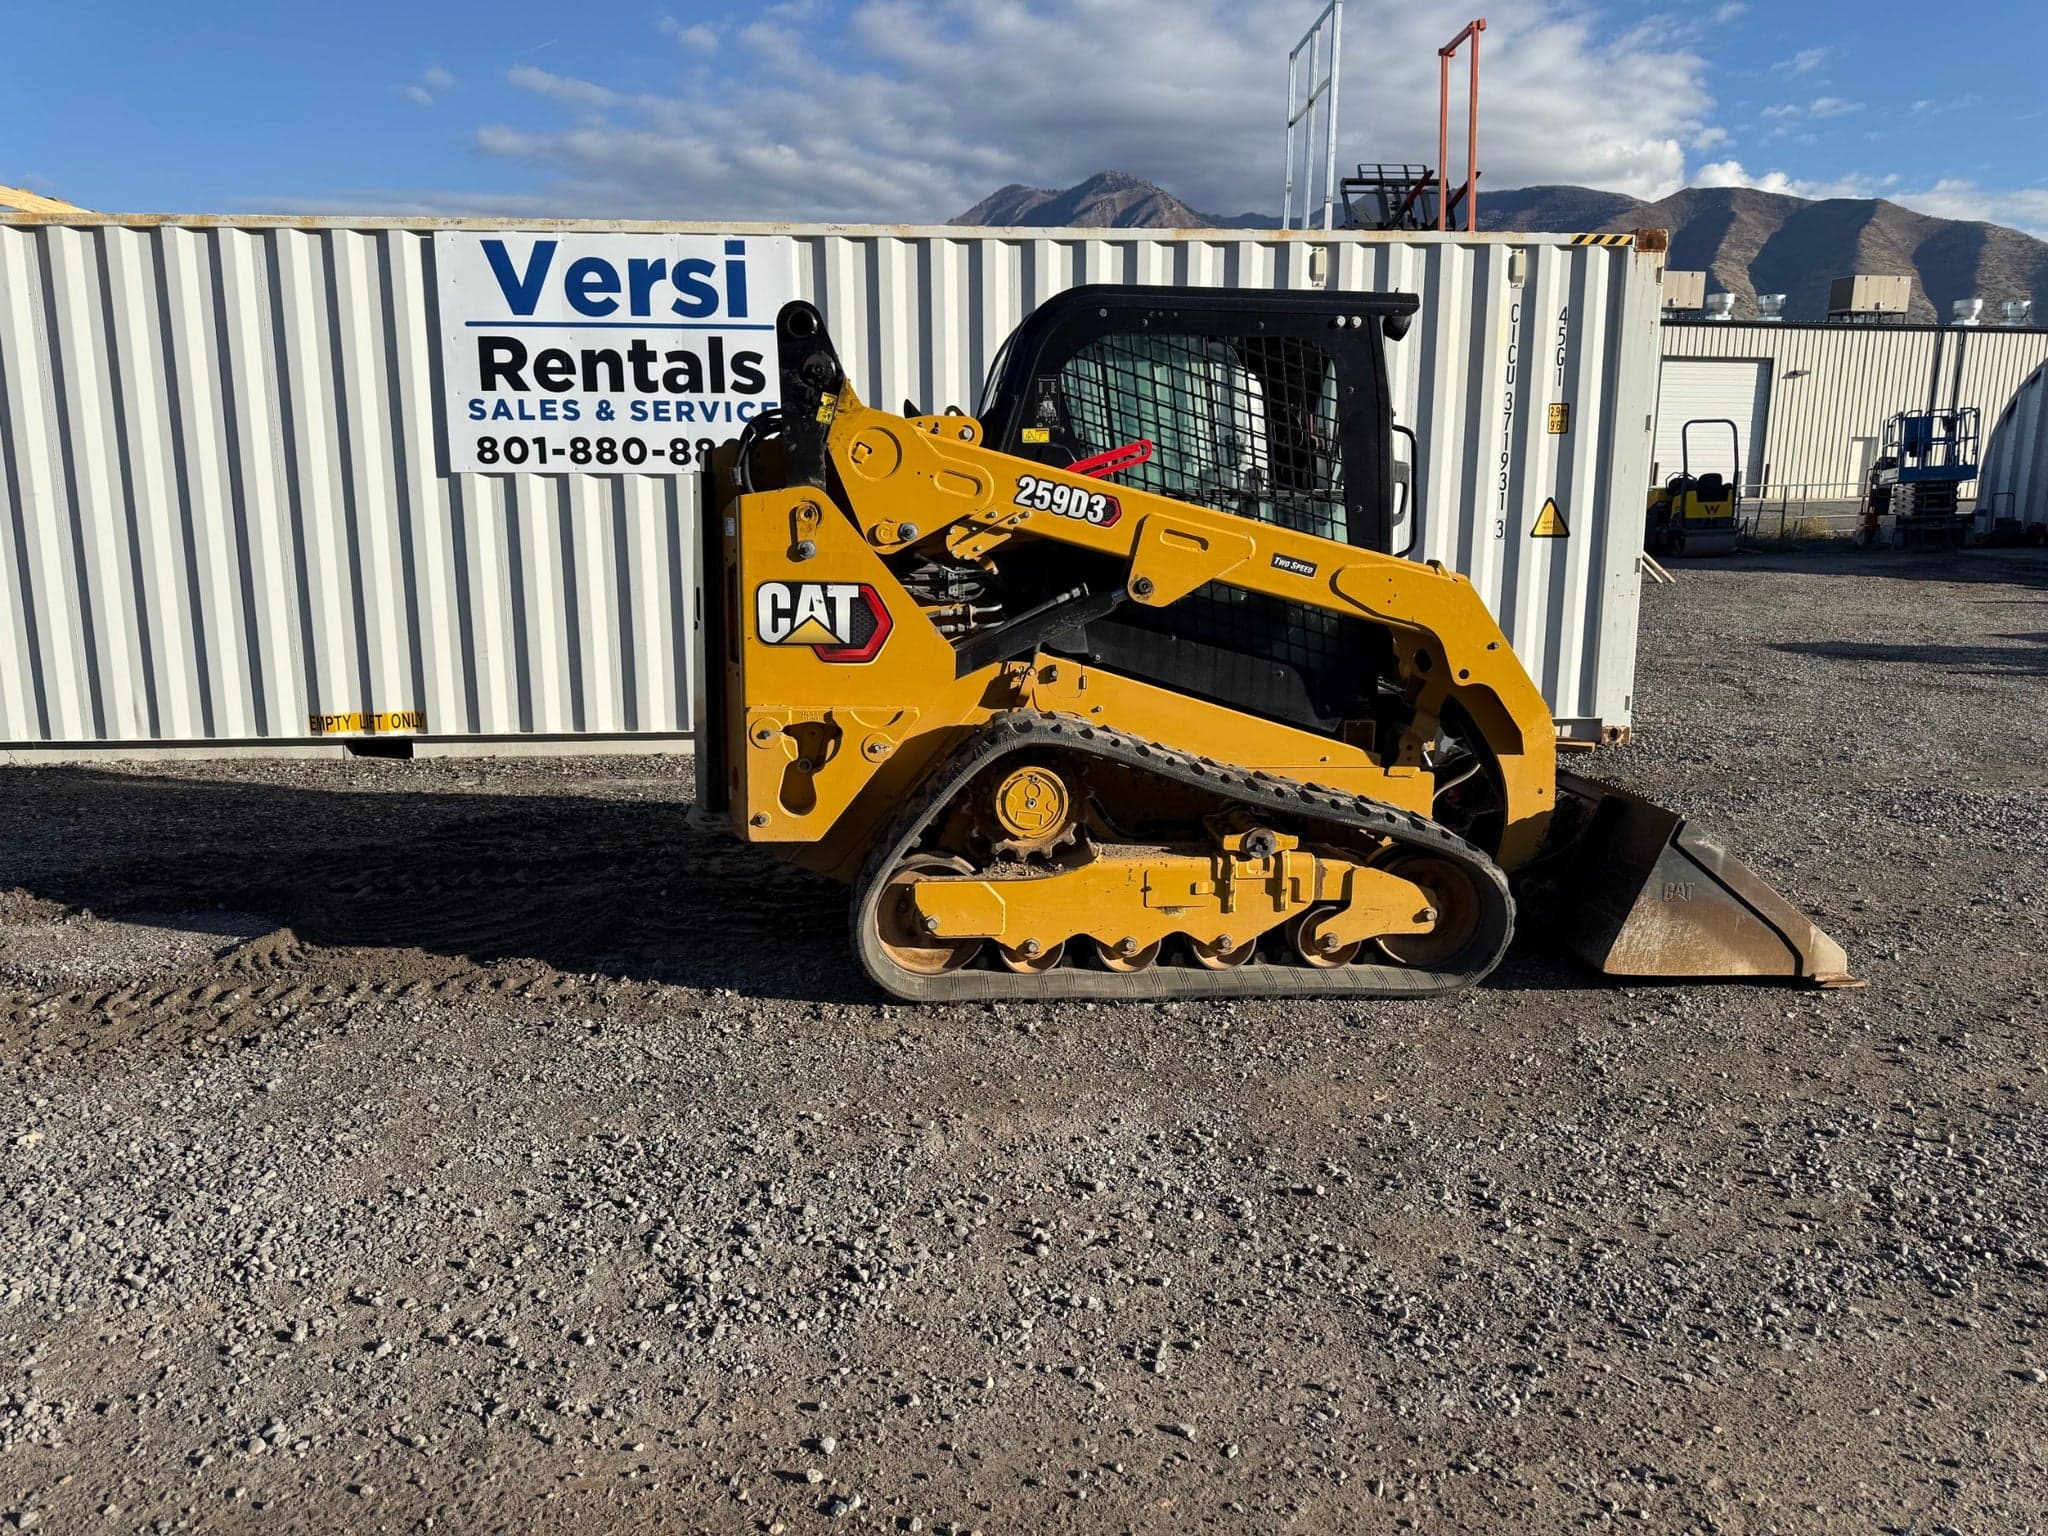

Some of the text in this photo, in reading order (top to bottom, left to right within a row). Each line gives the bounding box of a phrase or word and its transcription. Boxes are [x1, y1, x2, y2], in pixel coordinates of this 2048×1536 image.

[480, 239, 748, 318] Versi
[477, 335, 766, 394] Rentals
[468, 398, 581, 421] SALES
[595, 399, 616, 421] &
[476, 436, 740, 466] 801-880-88
[1014, 475, 1108, 524] 259D3
[758, 582, 860, 645] CAT
[309, 713, 425, 731] EMPTY LIFT ONLY
[1662, 881, 1696, 902] CAT
